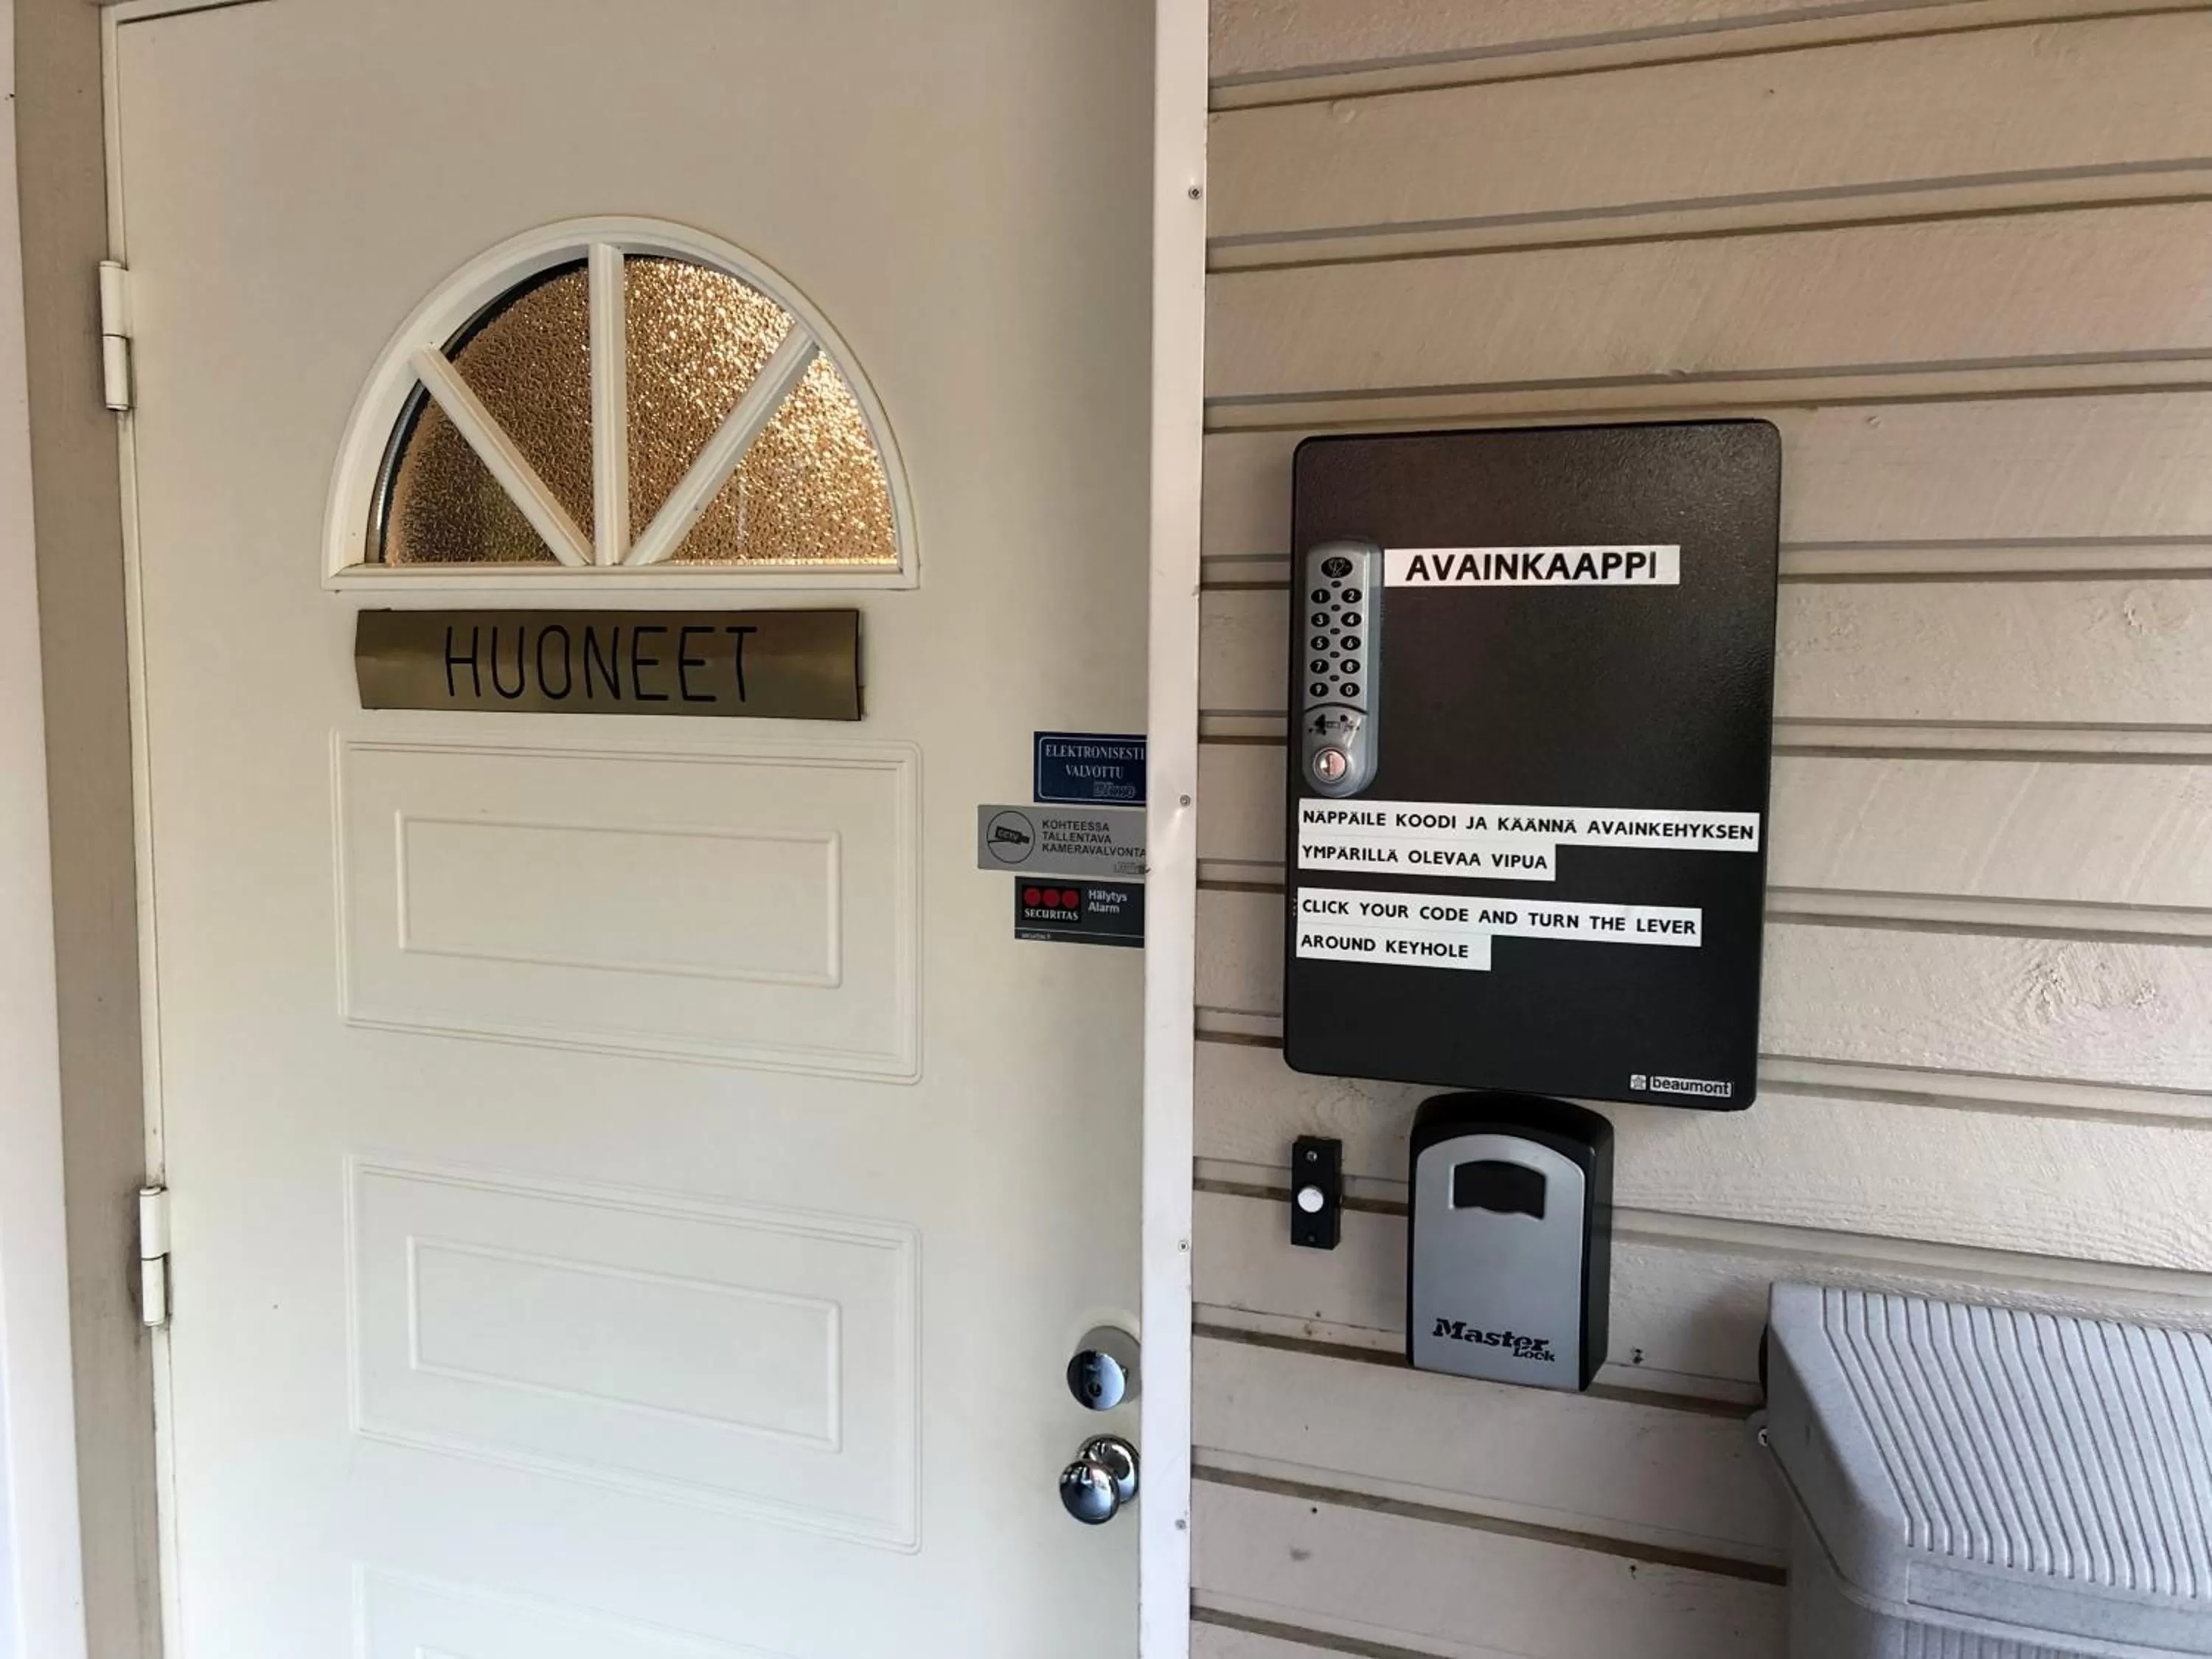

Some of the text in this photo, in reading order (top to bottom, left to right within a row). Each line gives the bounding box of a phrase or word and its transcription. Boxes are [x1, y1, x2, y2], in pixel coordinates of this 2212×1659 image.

[1405, 551, 1657, 581] AVAINKAAPPI
[1318, 592, 1355, 602] 1 2
[1317, 615, 1355, 625] 3 4
[1316, 639, 1354, 649] 5 6
[445, 625, 758, 703] HUONEET
[1315, 661, 1353, 672] 7 8
[1315, 686, 1353, 695] 9 0
[1046, 744, 1144, 760] ELEKTRONISESTI
[1065, 764, 1124, 779] VALVOTTU
[1042, 820, 1110, 832] KOHTEESSA
[1303, 810, 1753, 840] NÄPPÄILE KOODI JA KÄÄNNÄ AVAINKEHYKSEN
[1041, 832, 1112, 844] TALLENTAVA
[1042, 844, 1146, 858] KAMERAVALVONTA
[1302, 844, 1548, 869] YMPÄRILLÄ OLEVAA VIPUA
[1088, 889, 1127, 902] Hälytys
[1024, 908, 1079, 920] SECURITAS
[1088, 901, 1120, 913] Alarm
[1302, 899, 1696, 935] CLICK YOUR CODE AND TURN THE LEVER
[1301, 934, 1468, 959] AROUND KEYHOLE
[1652, 1077, 1731, 1096] beaumont
[1433, 1318, 1549, 1352] Master
[1513, 1347, 1555, 1363] Lock
